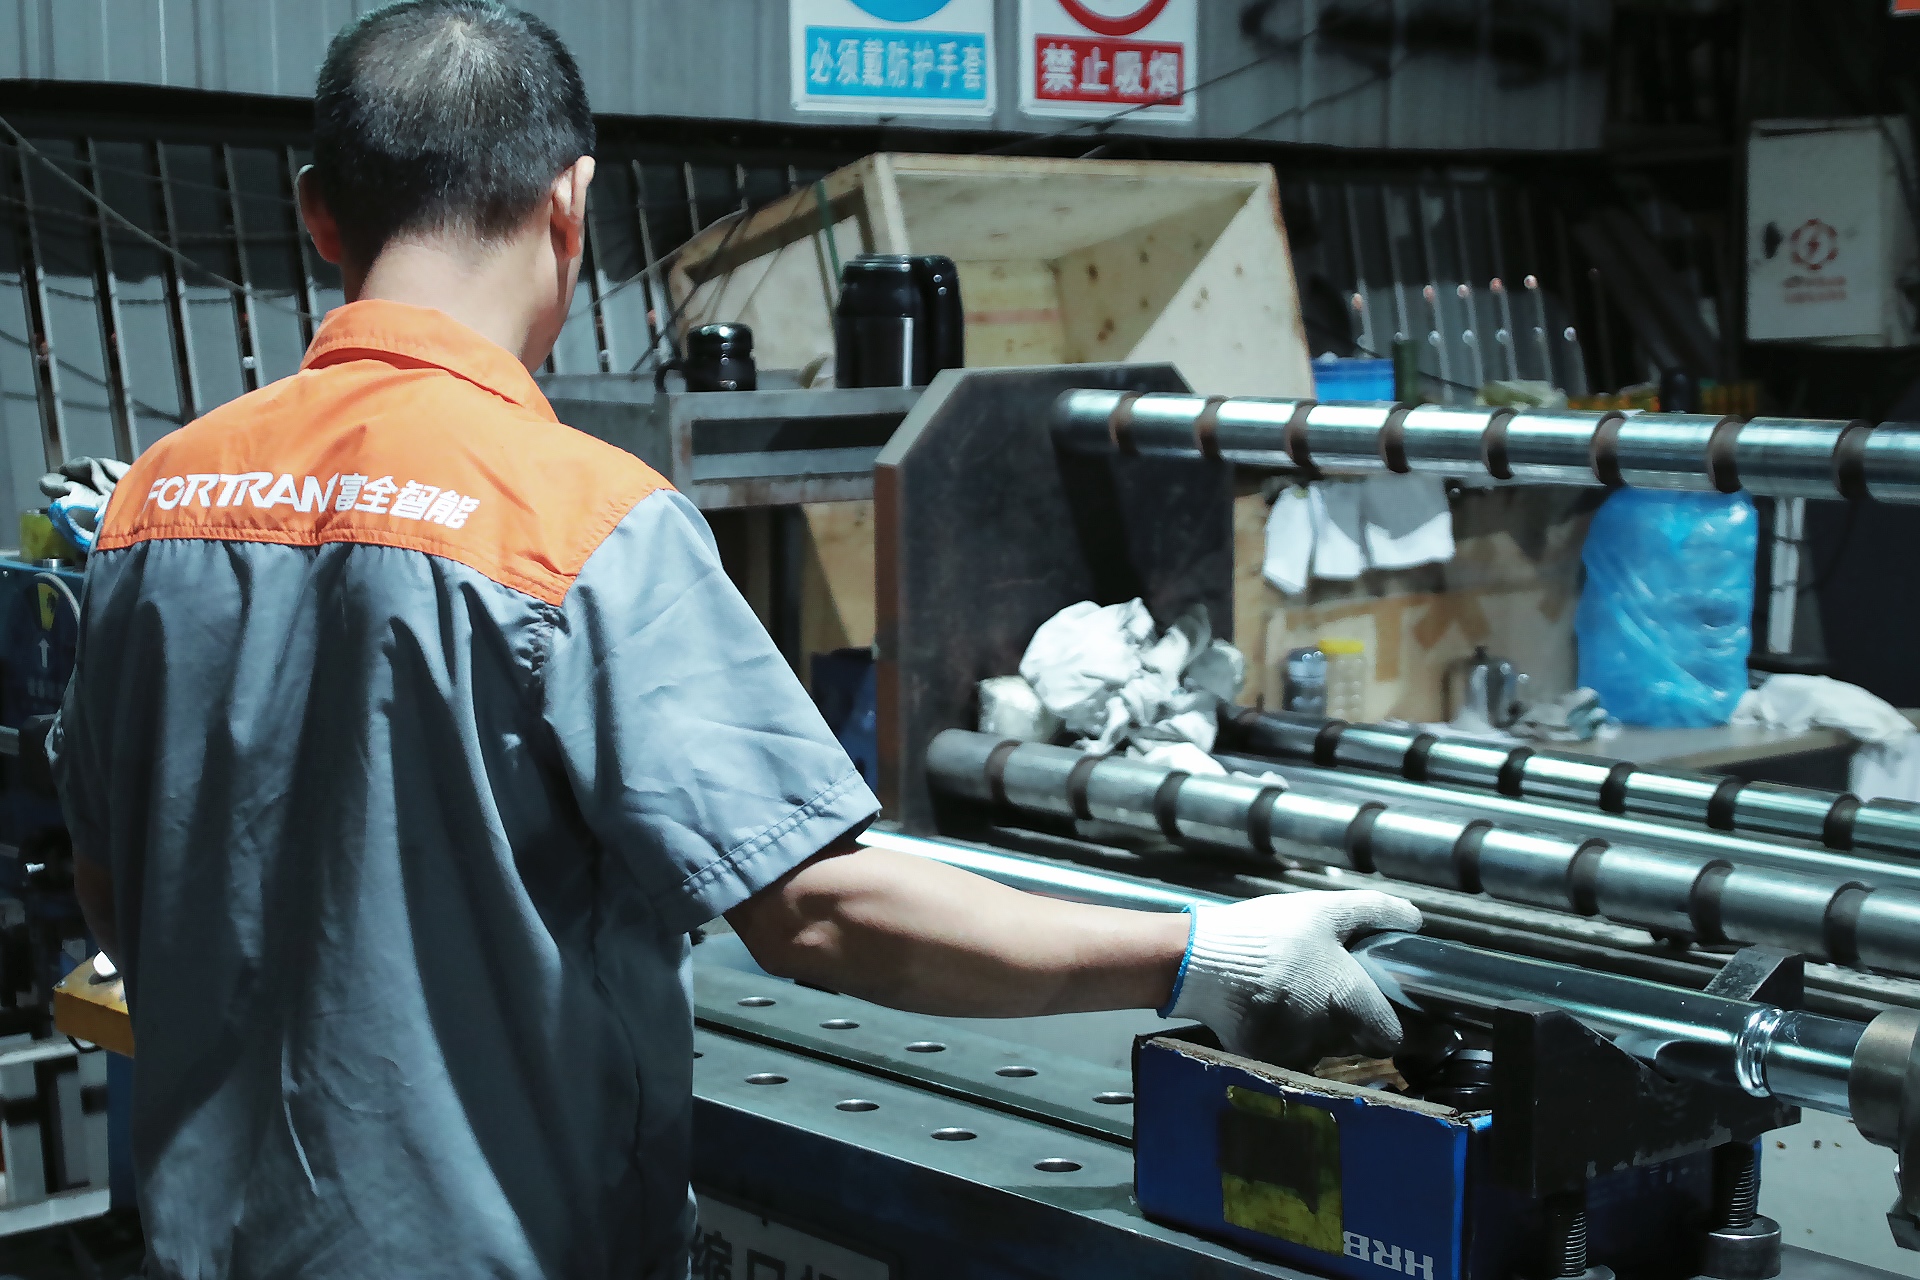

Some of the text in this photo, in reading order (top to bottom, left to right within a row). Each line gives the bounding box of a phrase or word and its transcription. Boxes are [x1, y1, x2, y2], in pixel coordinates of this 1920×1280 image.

[810, 37, 985, 91] 必须戴防护手套
[1041, 41, 1180, 96] 禁止吸烟
[142, 471, 340, 513] FORTRAN
[334, 472, 481, 529] 富全智能
[1343, 1230, 1434, 1280] HRB
